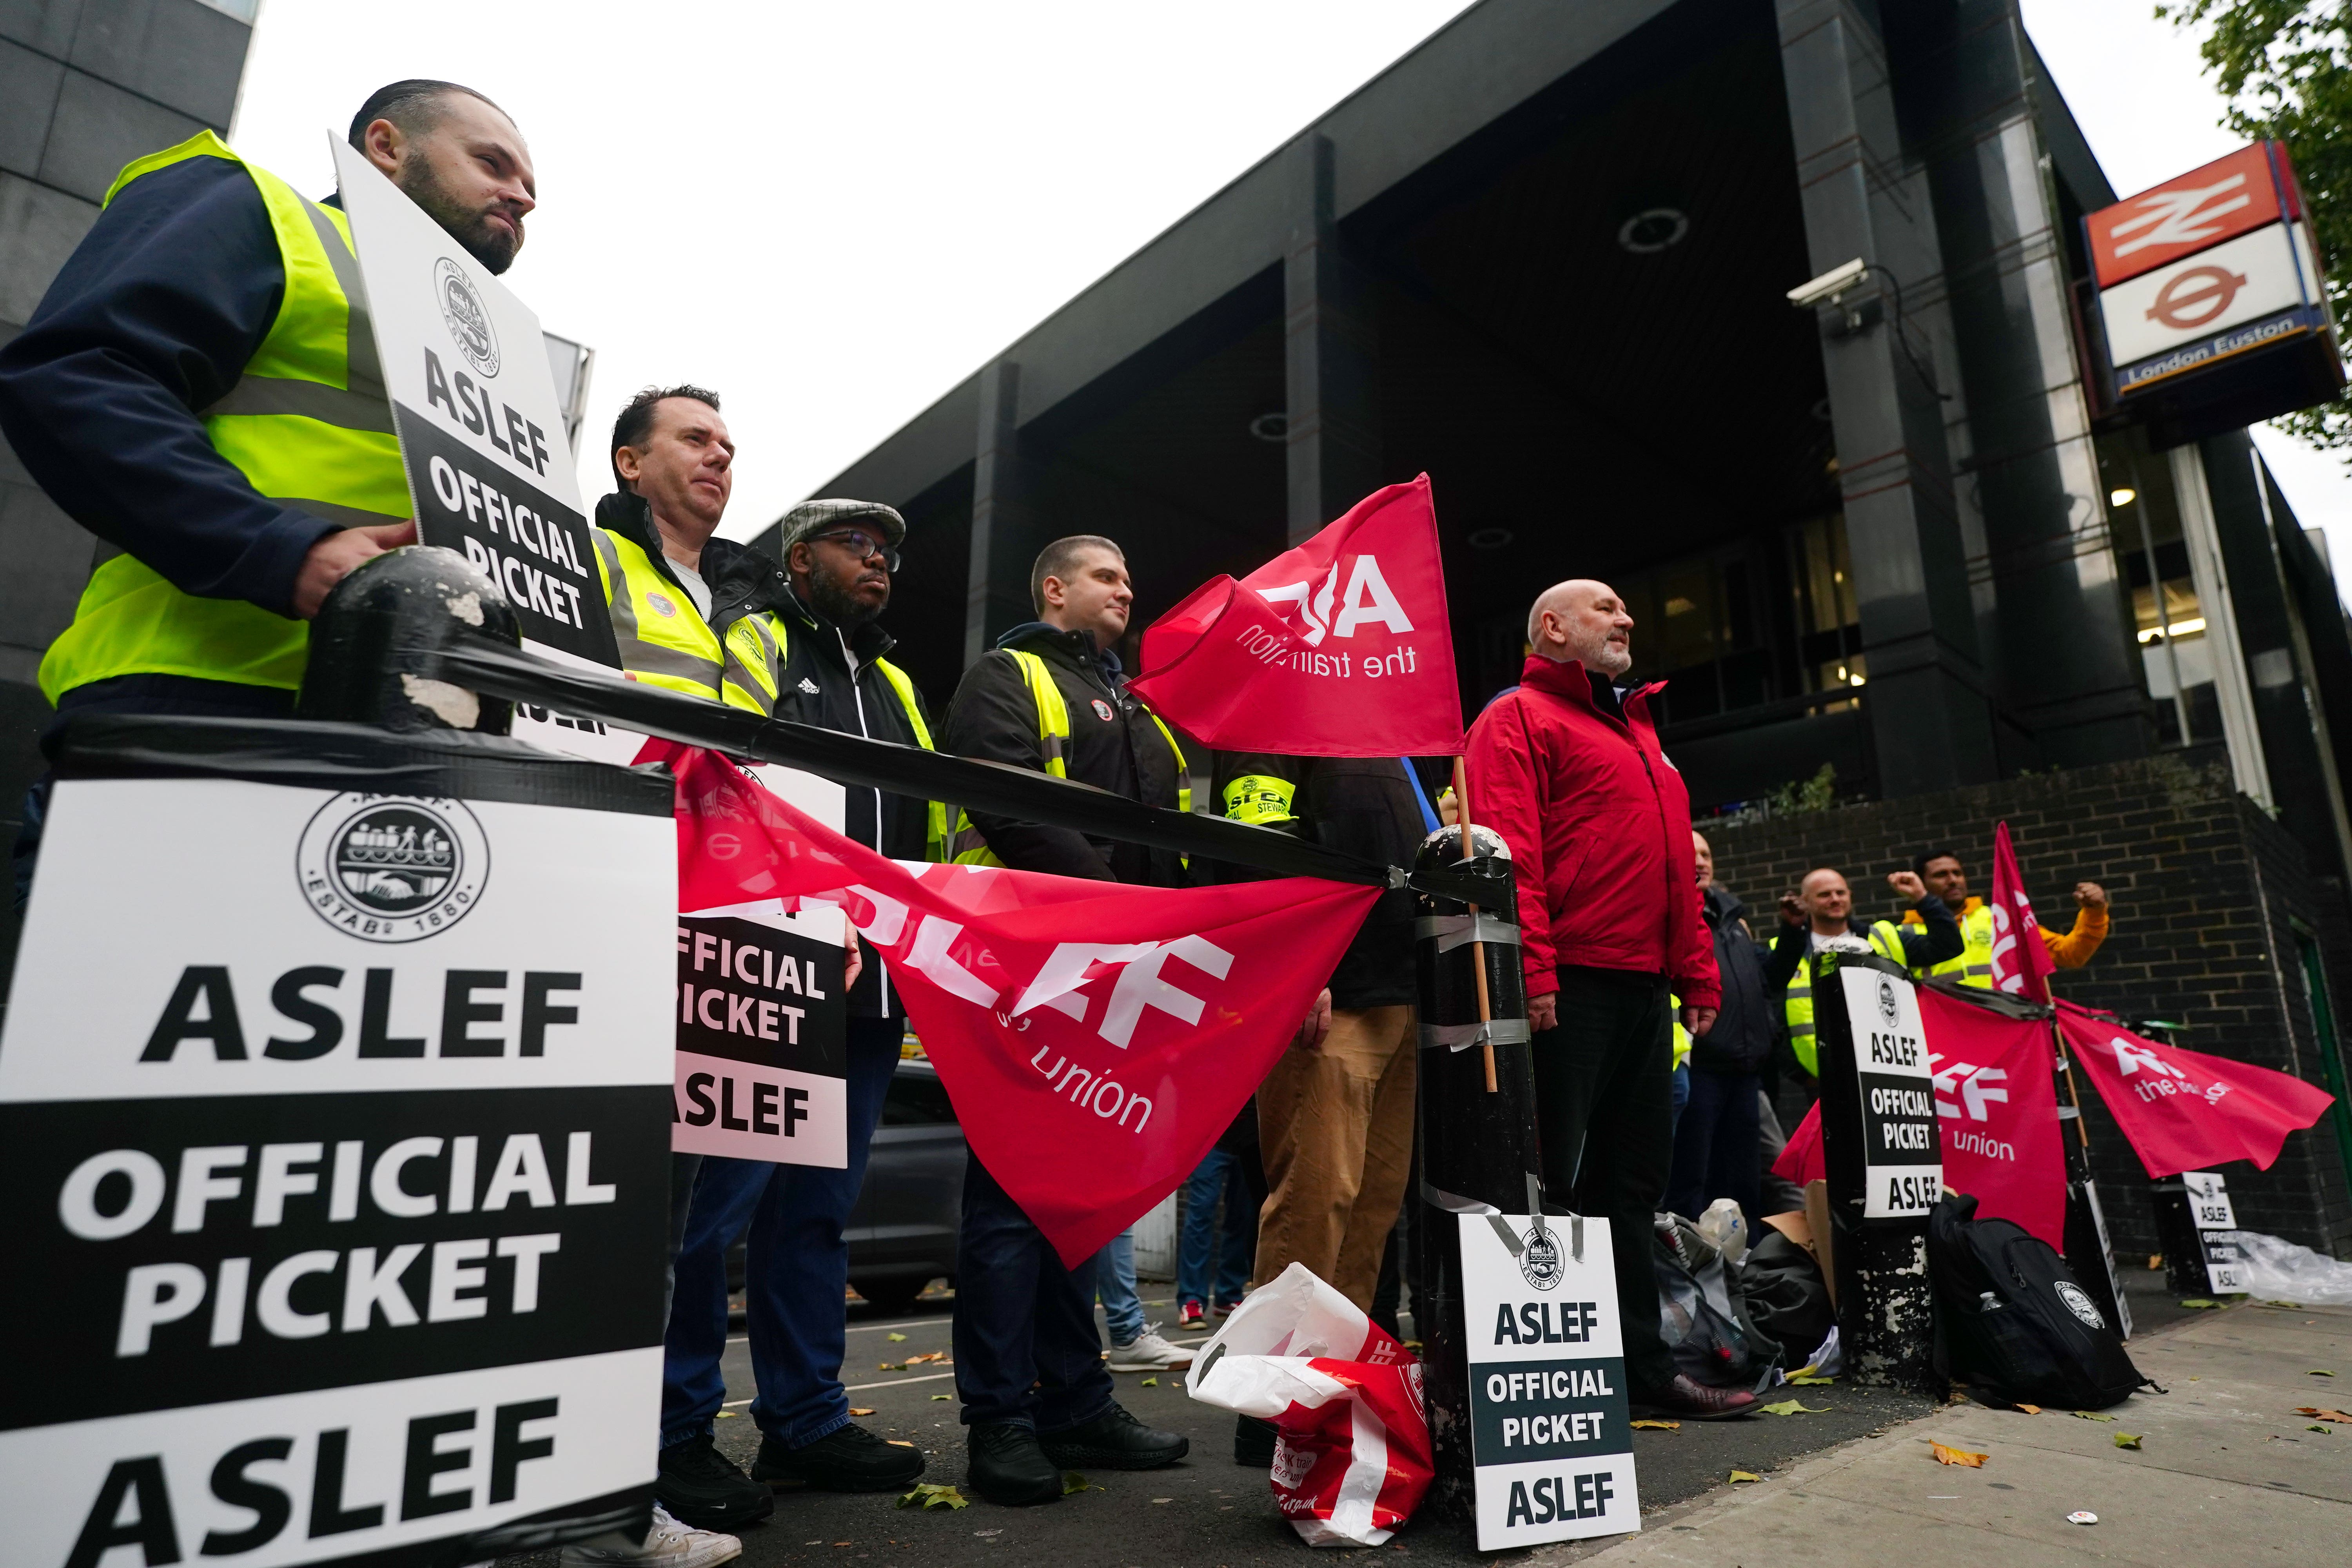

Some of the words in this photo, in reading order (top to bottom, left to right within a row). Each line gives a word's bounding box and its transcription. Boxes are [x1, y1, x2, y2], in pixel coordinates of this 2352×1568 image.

[2128, 347, 2210, 384] London
[2213, 317, 2295, 354] Euston
[424, 345, 550, 477] ASLEF
[429, 456, 588, 579] OFFICIAL
[463, 535, 583, 630] PICKET
[1227, 792, 1288, 813] SLEF
[414, 891, 470, 932] 1880
[138, 965, 583, 1063] ASLEF
[677, 982, 805, 1045] ICKET
[1871, 1032, 1918, 1067] ASLEF
[673, 1072, 809, 1138] SLEF
[1031, 1045, 1153, 1134] union
[1871, 1087, 1933, 1117] OFFICIAL
[2134, 1079, 2177, 1102] the
[1882, 1122, 1930, 1150] PICKET
[1953, 1130, 2014, 1161] union
[58, 1132, 616, 1241] OFFICIAL
[1889, 1176, 1936, 1210] ASLEF
[116, 1233, 561, 1358] PICKET
[1549, 1269, 1562, 1286] 1880
[1494, 1302, 1597, 1345] ASLEF
[1486, 1369, 1614, 1403] OFFICIAL
[1503, 1412, 1604, 1447] PICKET
[63, 1396, 560, 1568] ASLEF
[1296, 1457, 1312, 1469] train
[1506, 1472, 1614, 1528] ASLEF
